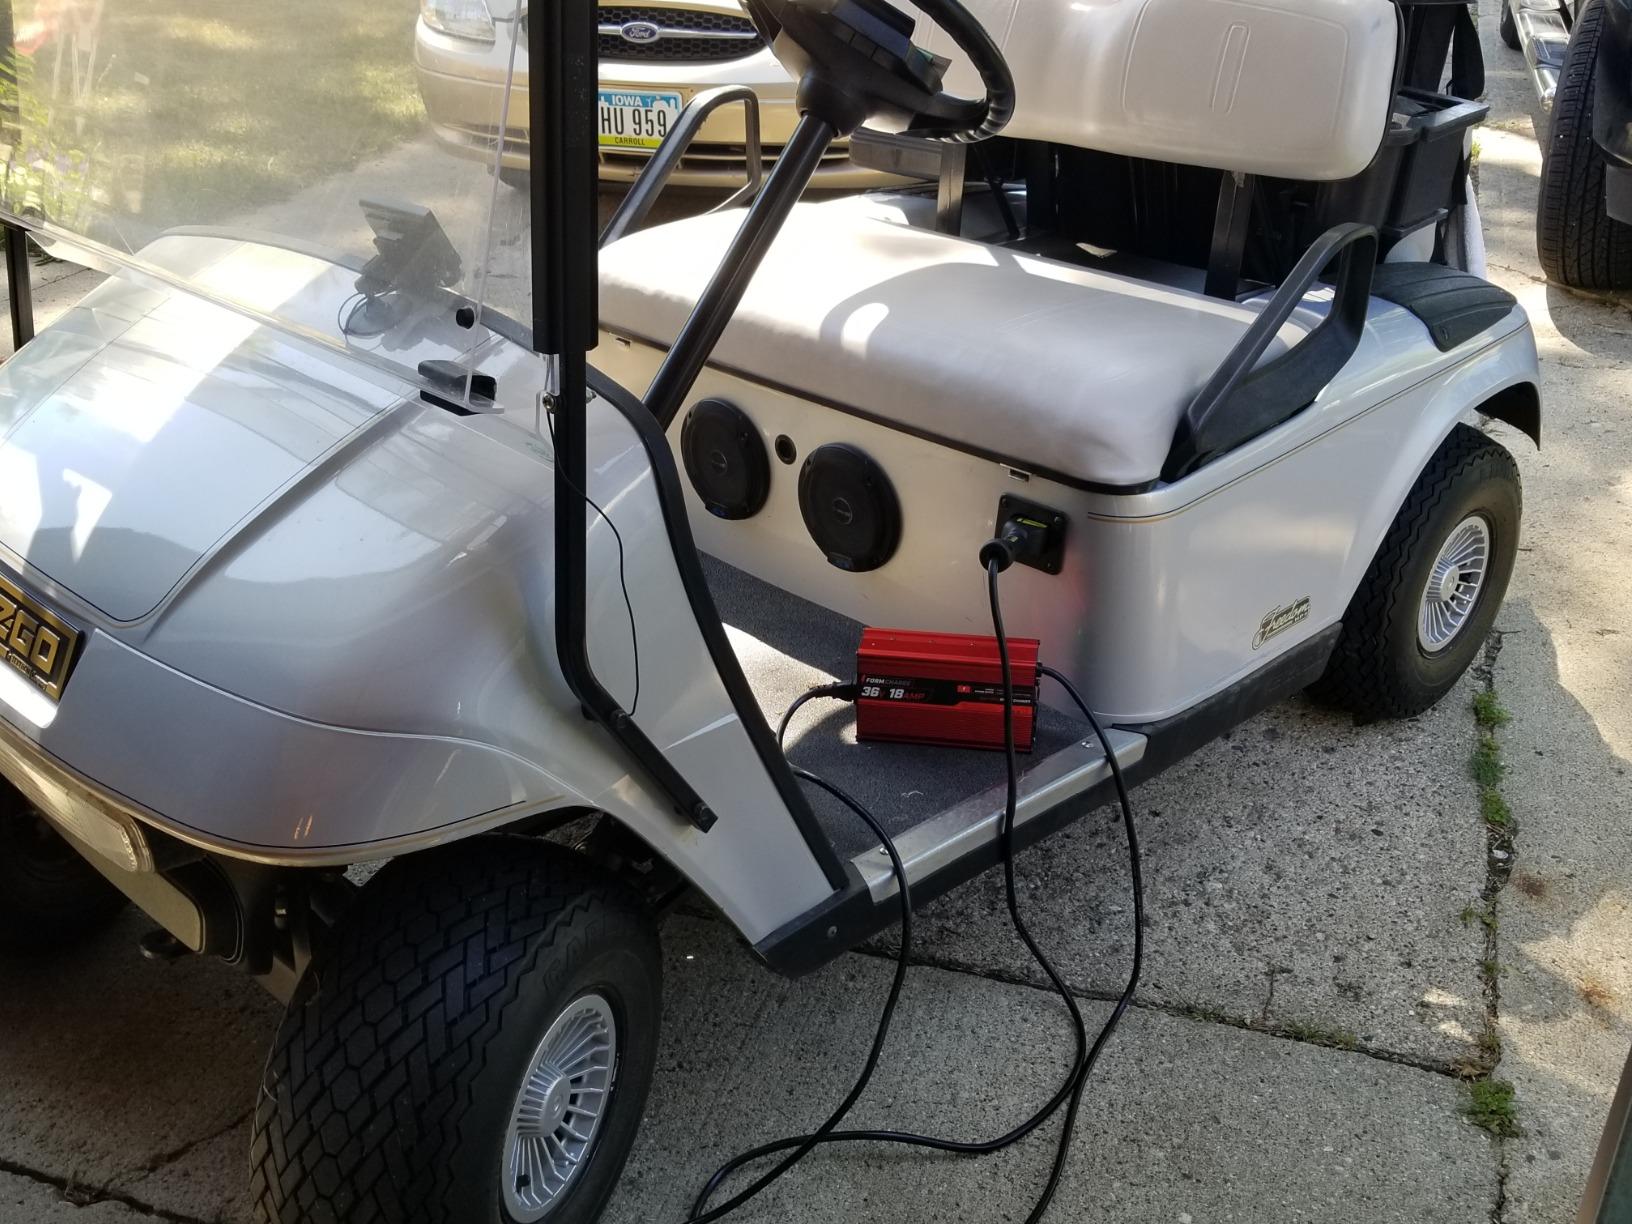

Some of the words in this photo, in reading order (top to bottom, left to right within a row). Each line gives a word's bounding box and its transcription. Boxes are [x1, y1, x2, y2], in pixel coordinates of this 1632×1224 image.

[629, 27, 650, 39] Ford
[612, 95, 643, 107] IOWA
[632, 108, 667, 138] 959
[615, 137, 646, 146] CARROLL
